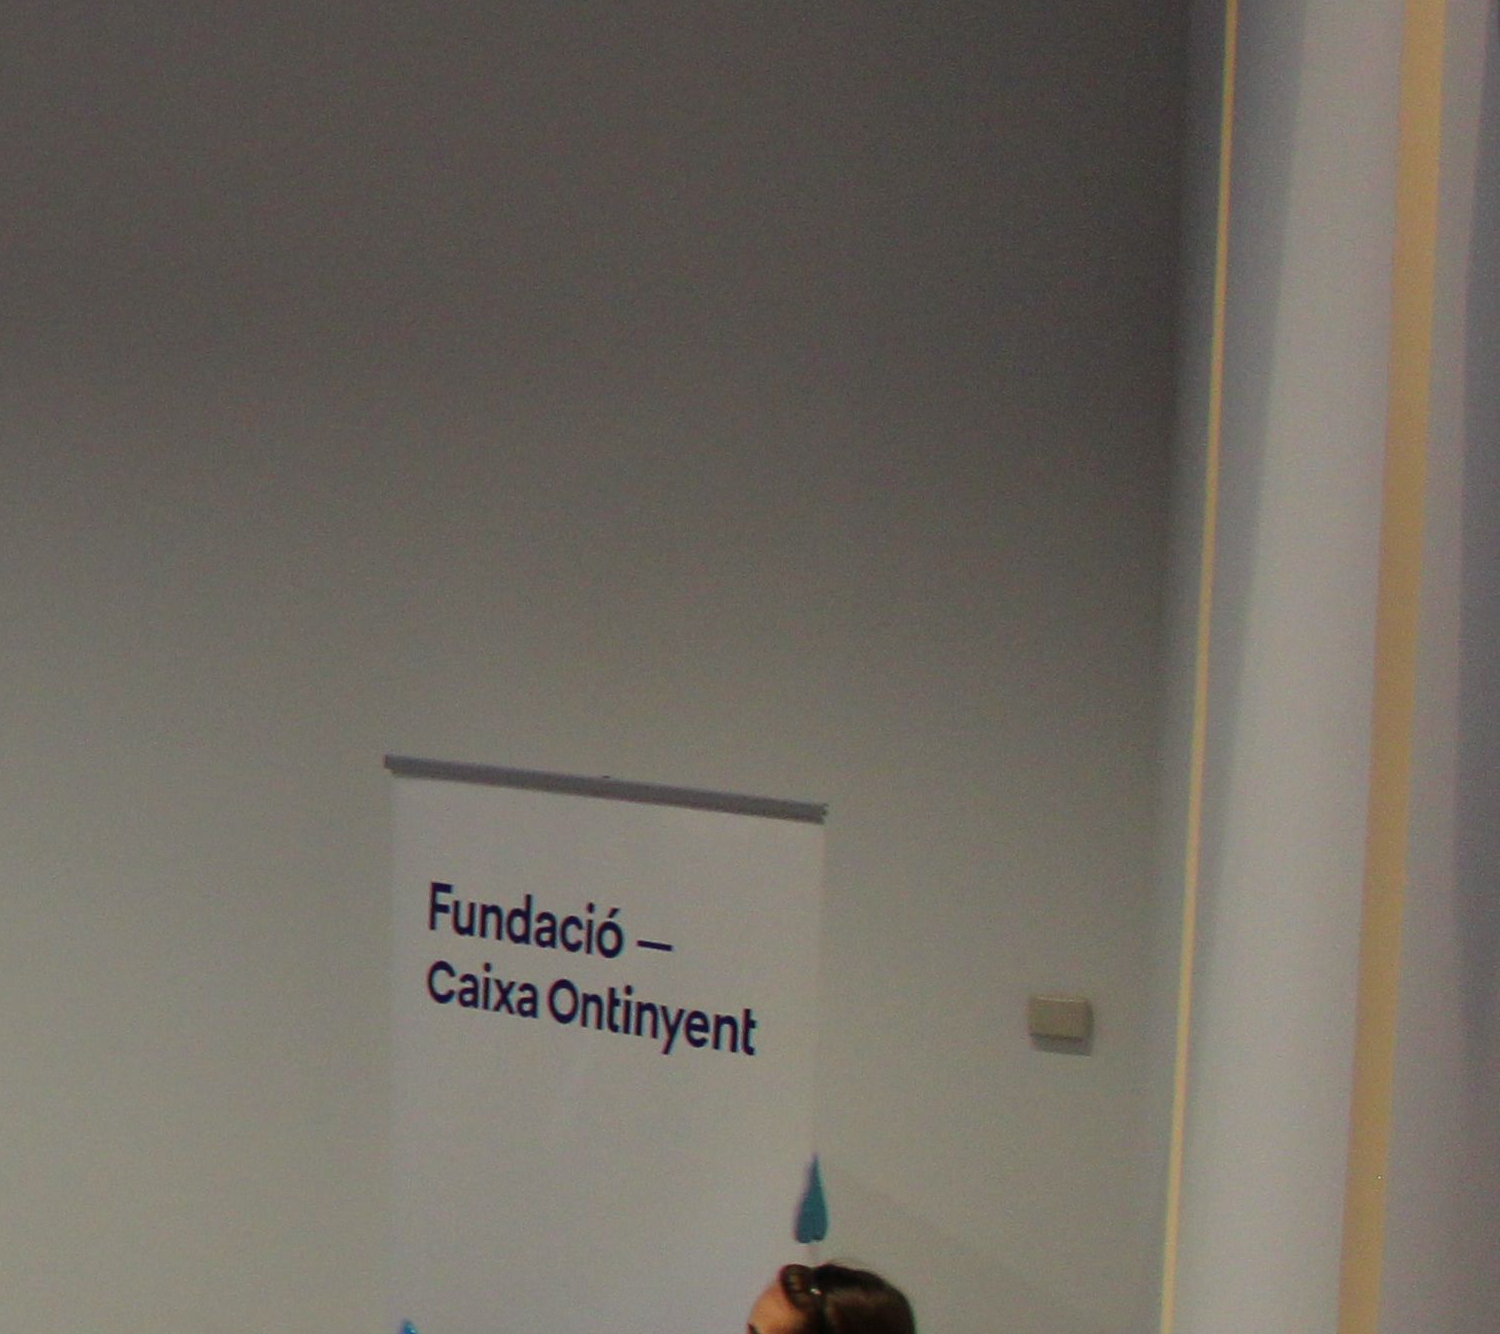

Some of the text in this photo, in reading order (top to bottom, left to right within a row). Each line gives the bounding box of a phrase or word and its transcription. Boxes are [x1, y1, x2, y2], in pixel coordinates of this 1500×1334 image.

[428, 881, 625, 959] Fundació
[427, 960, 758, 1056] Caixa Ontinyent
